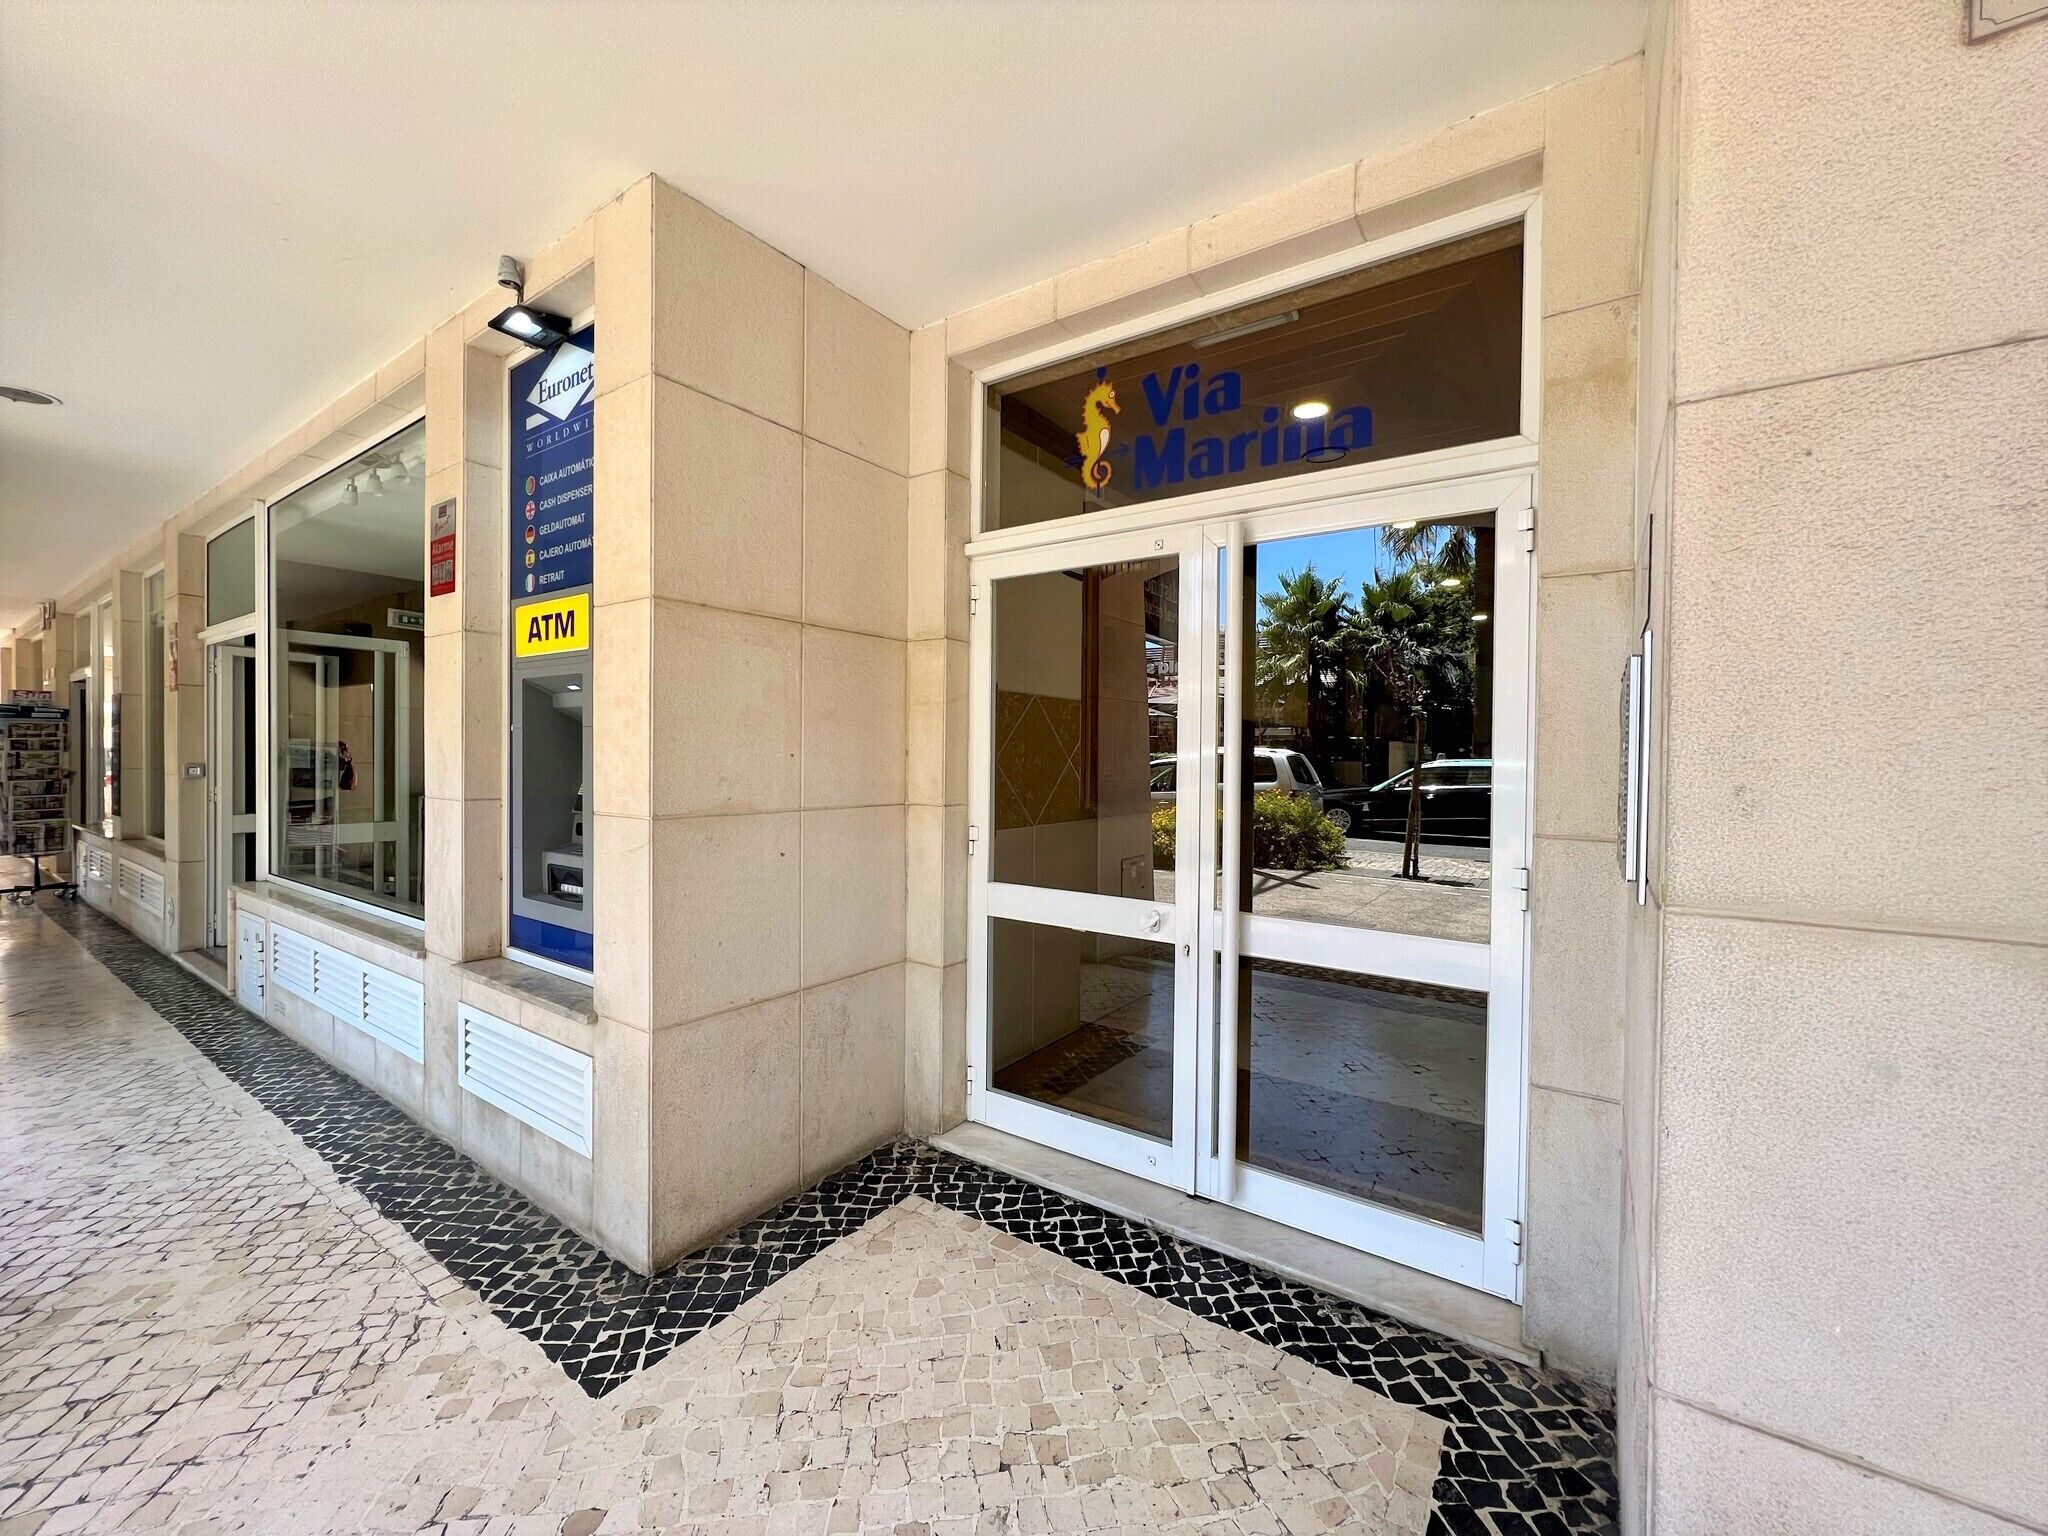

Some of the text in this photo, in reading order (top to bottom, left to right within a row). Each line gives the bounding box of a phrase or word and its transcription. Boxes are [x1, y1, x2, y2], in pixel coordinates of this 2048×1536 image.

[538, 361, 594, 405] Euronet
[1142, 363, 1241, 427] Via
[1132, 405, 1373, 491] Marina
[539, 471, 558, 486] CAIXA
[539, 484, 593, 511] CASH DISPENSER
[539, 512, 586, 536] GELDAUTOMAT
[539, 544, 564, 560] CAJERO
[538, 570, 565, 585] RETRAIT
[527, 609, 575, 644] ATM
